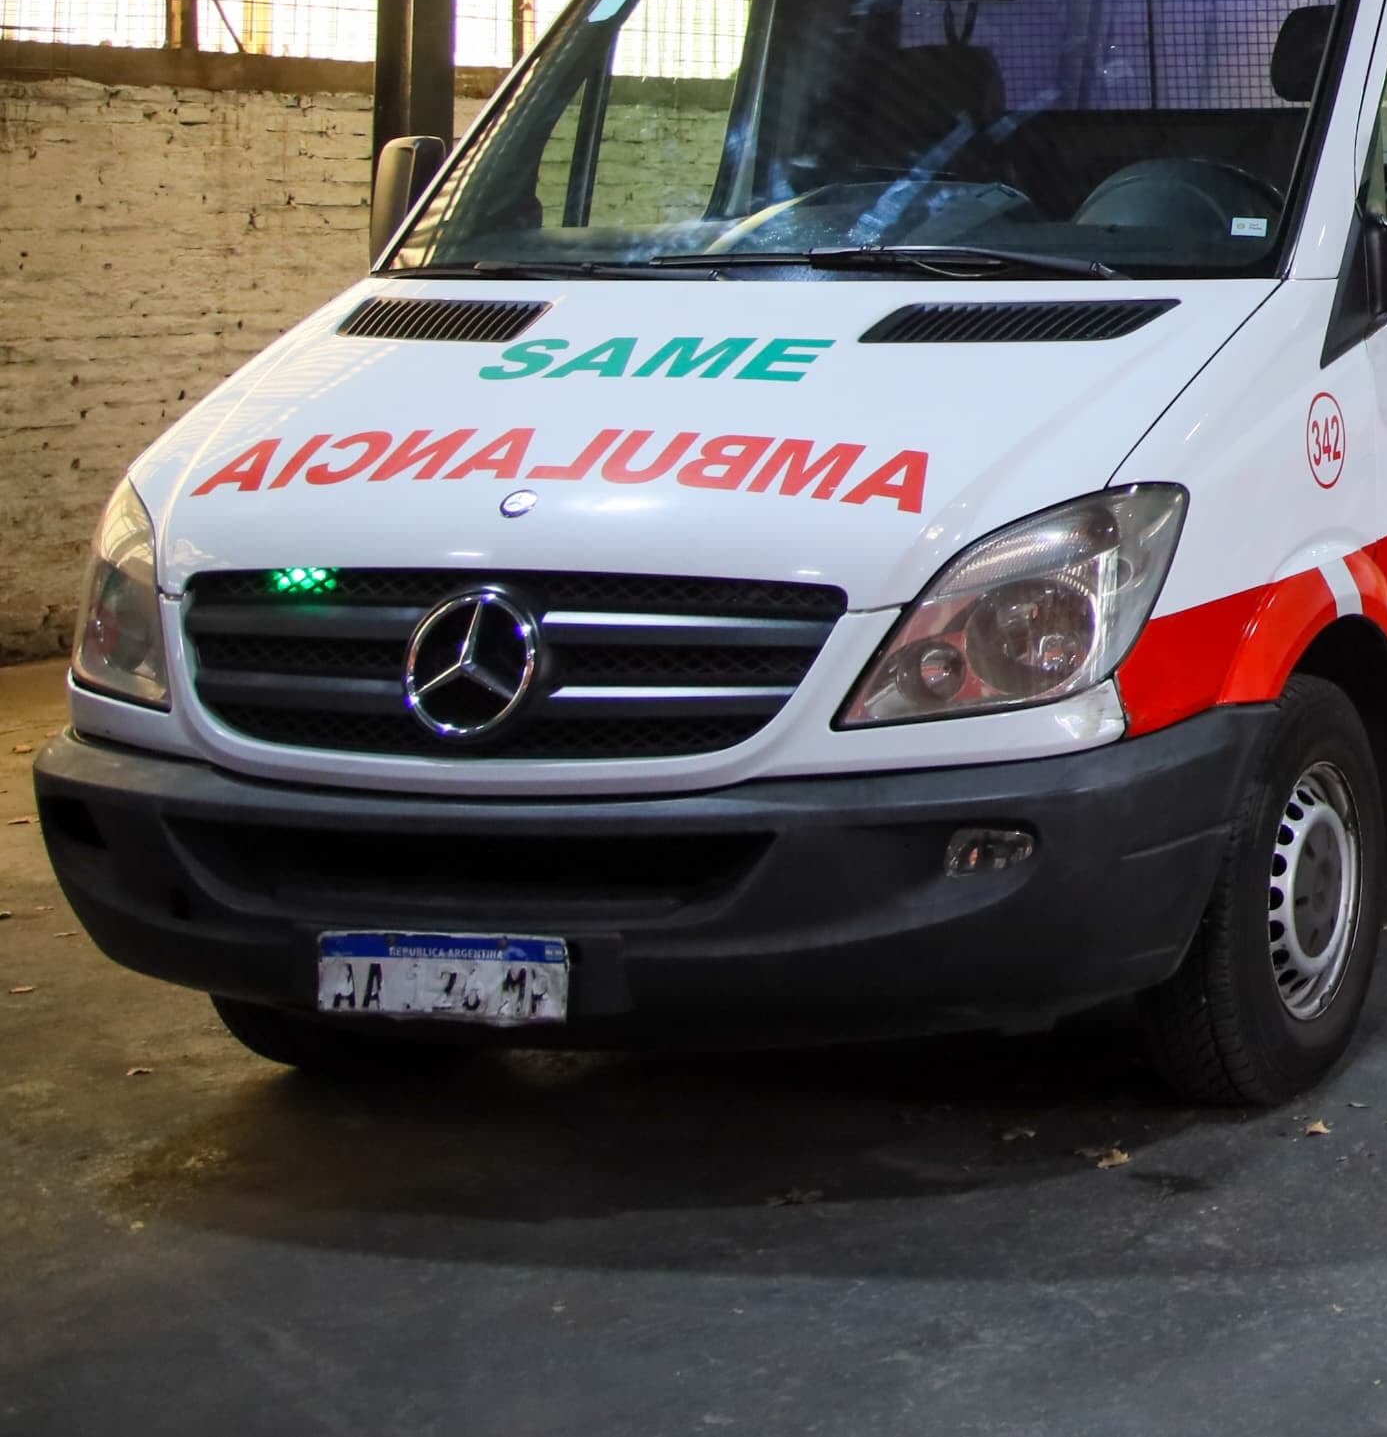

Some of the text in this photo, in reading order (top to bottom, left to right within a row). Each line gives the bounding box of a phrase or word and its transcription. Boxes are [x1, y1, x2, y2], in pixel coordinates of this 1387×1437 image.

[478, 337, 838, 382] SAME
[1311, 414, 1342, 467] 342
[447, 948, 504, 960] ARGENTINA
